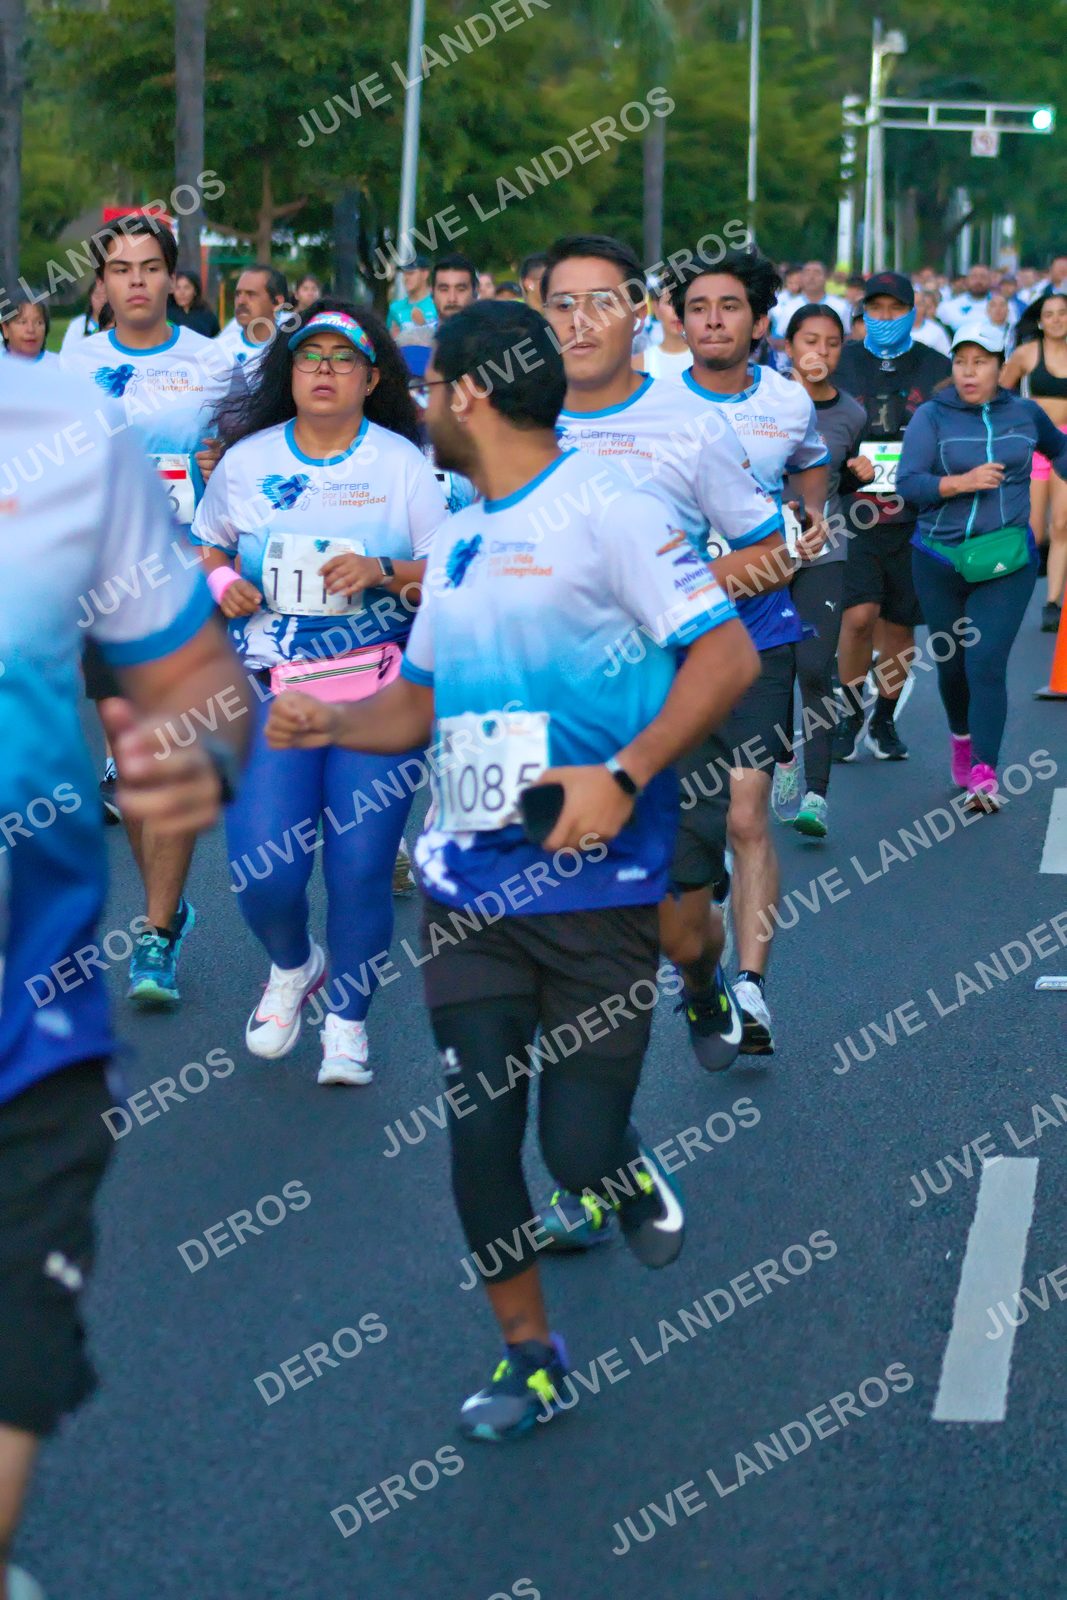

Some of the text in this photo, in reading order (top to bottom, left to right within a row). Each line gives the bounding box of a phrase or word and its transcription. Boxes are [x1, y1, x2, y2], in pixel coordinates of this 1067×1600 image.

[580, 429, 636, 442] Carrera
[610, 440, 634, 448] Vida
[322, 481, 370, 491] Carrera
[349, 490, 370, 499] Vida
[339, 496, 387, 507] Integridad
[270, 567, 352, 605] 111
